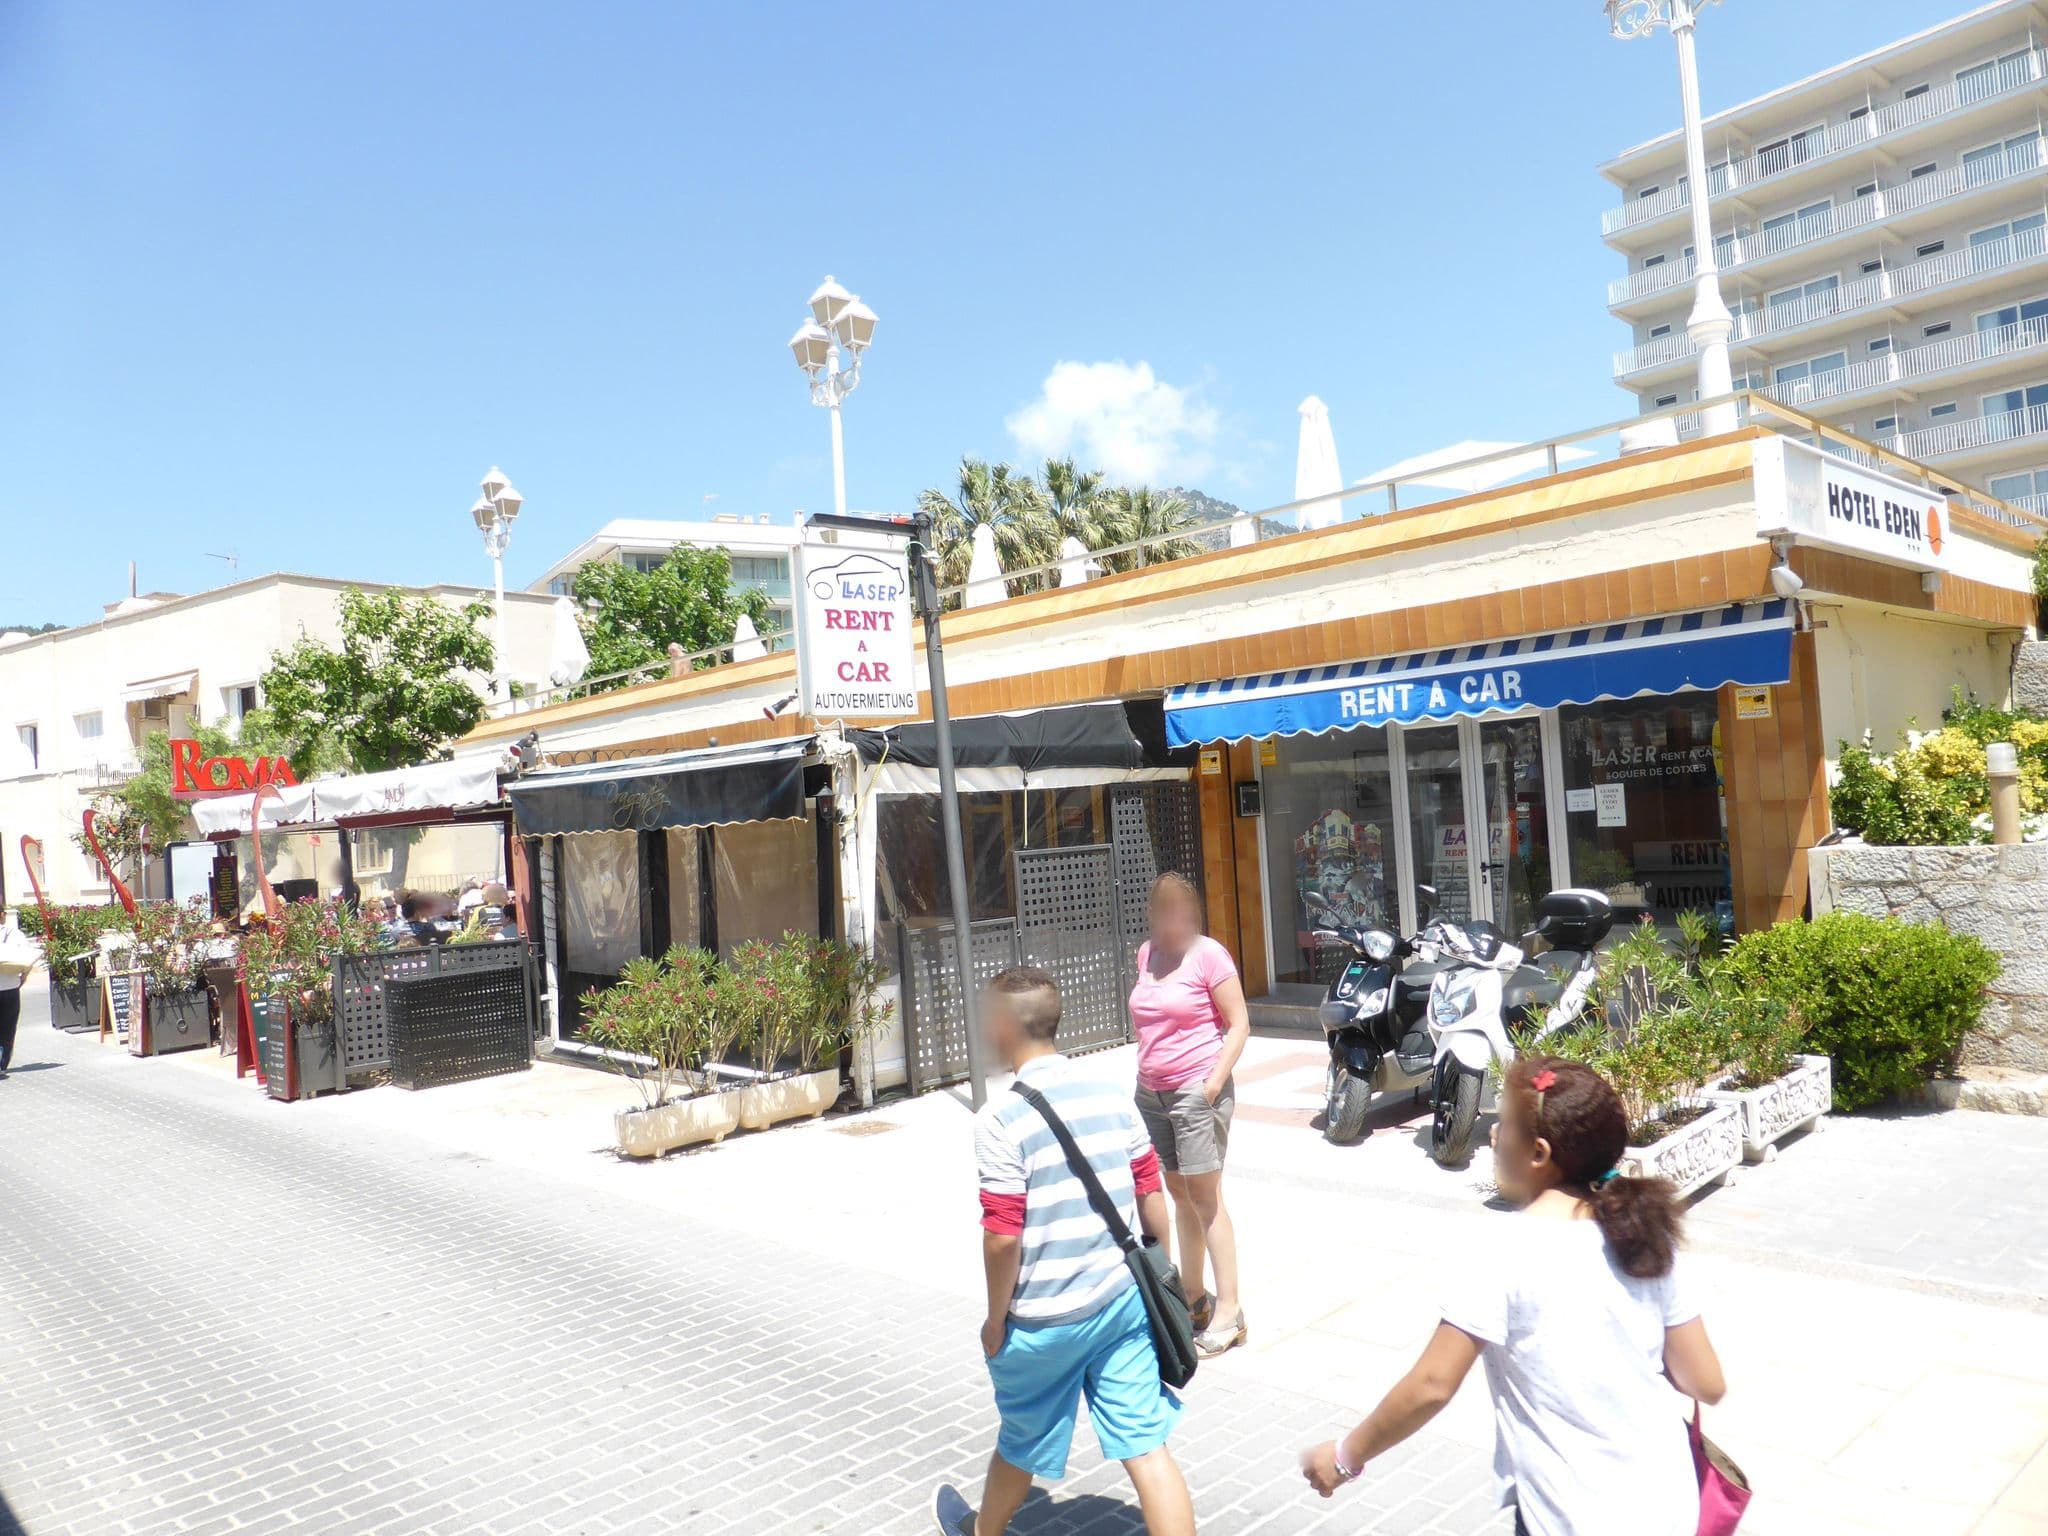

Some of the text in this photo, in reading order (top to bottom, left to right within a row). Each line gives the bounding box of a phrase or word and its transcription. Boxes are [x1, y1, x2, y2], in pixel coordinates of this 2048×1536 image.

[1827, 481, 1921, 541] HOTEL EDEN
[824, 608, 895, 632] RENT
[857, 639, 868, 653] A
[837, 661, 892, 683] CAR
[814, 693, 914, 709] AUTOVERMIETUNG
[1340, 670, 1522, 719] RENT A CAR
[1661, 749, 1686, 761] RENT
[1649, 767, 1664, 777] DE
[1665, 763, 1707, 775] COTXES
[1671, 842, 1720, 865] RENT
